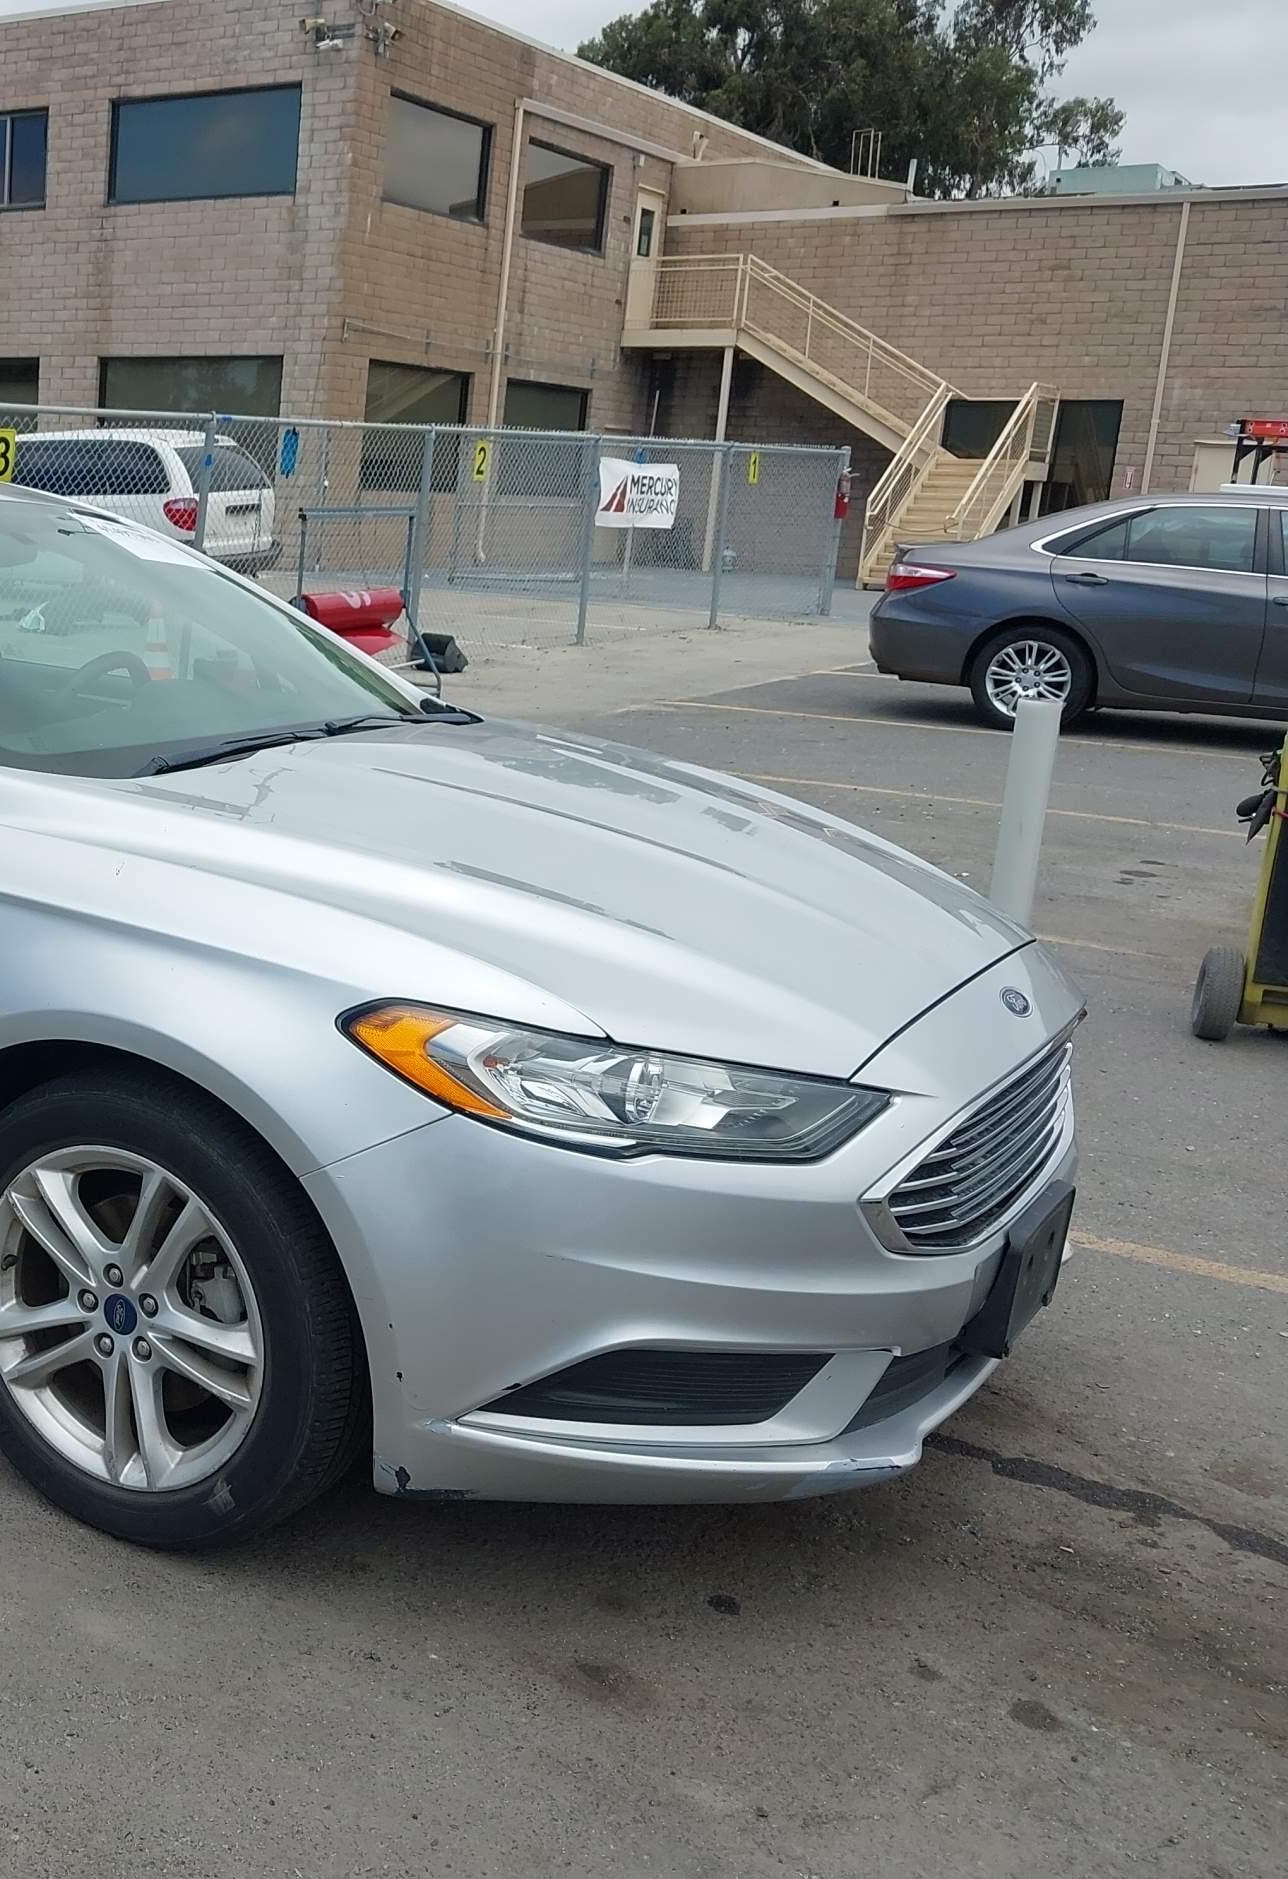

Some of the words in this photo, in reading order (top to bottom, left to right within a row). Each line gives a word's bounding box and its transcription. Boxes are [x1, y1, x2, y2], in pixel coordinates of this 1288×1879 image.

[476, 446, 487, 475] 2
[752, 455, 757, 480] 1
[626, 497, 676, 516] INSURANC
